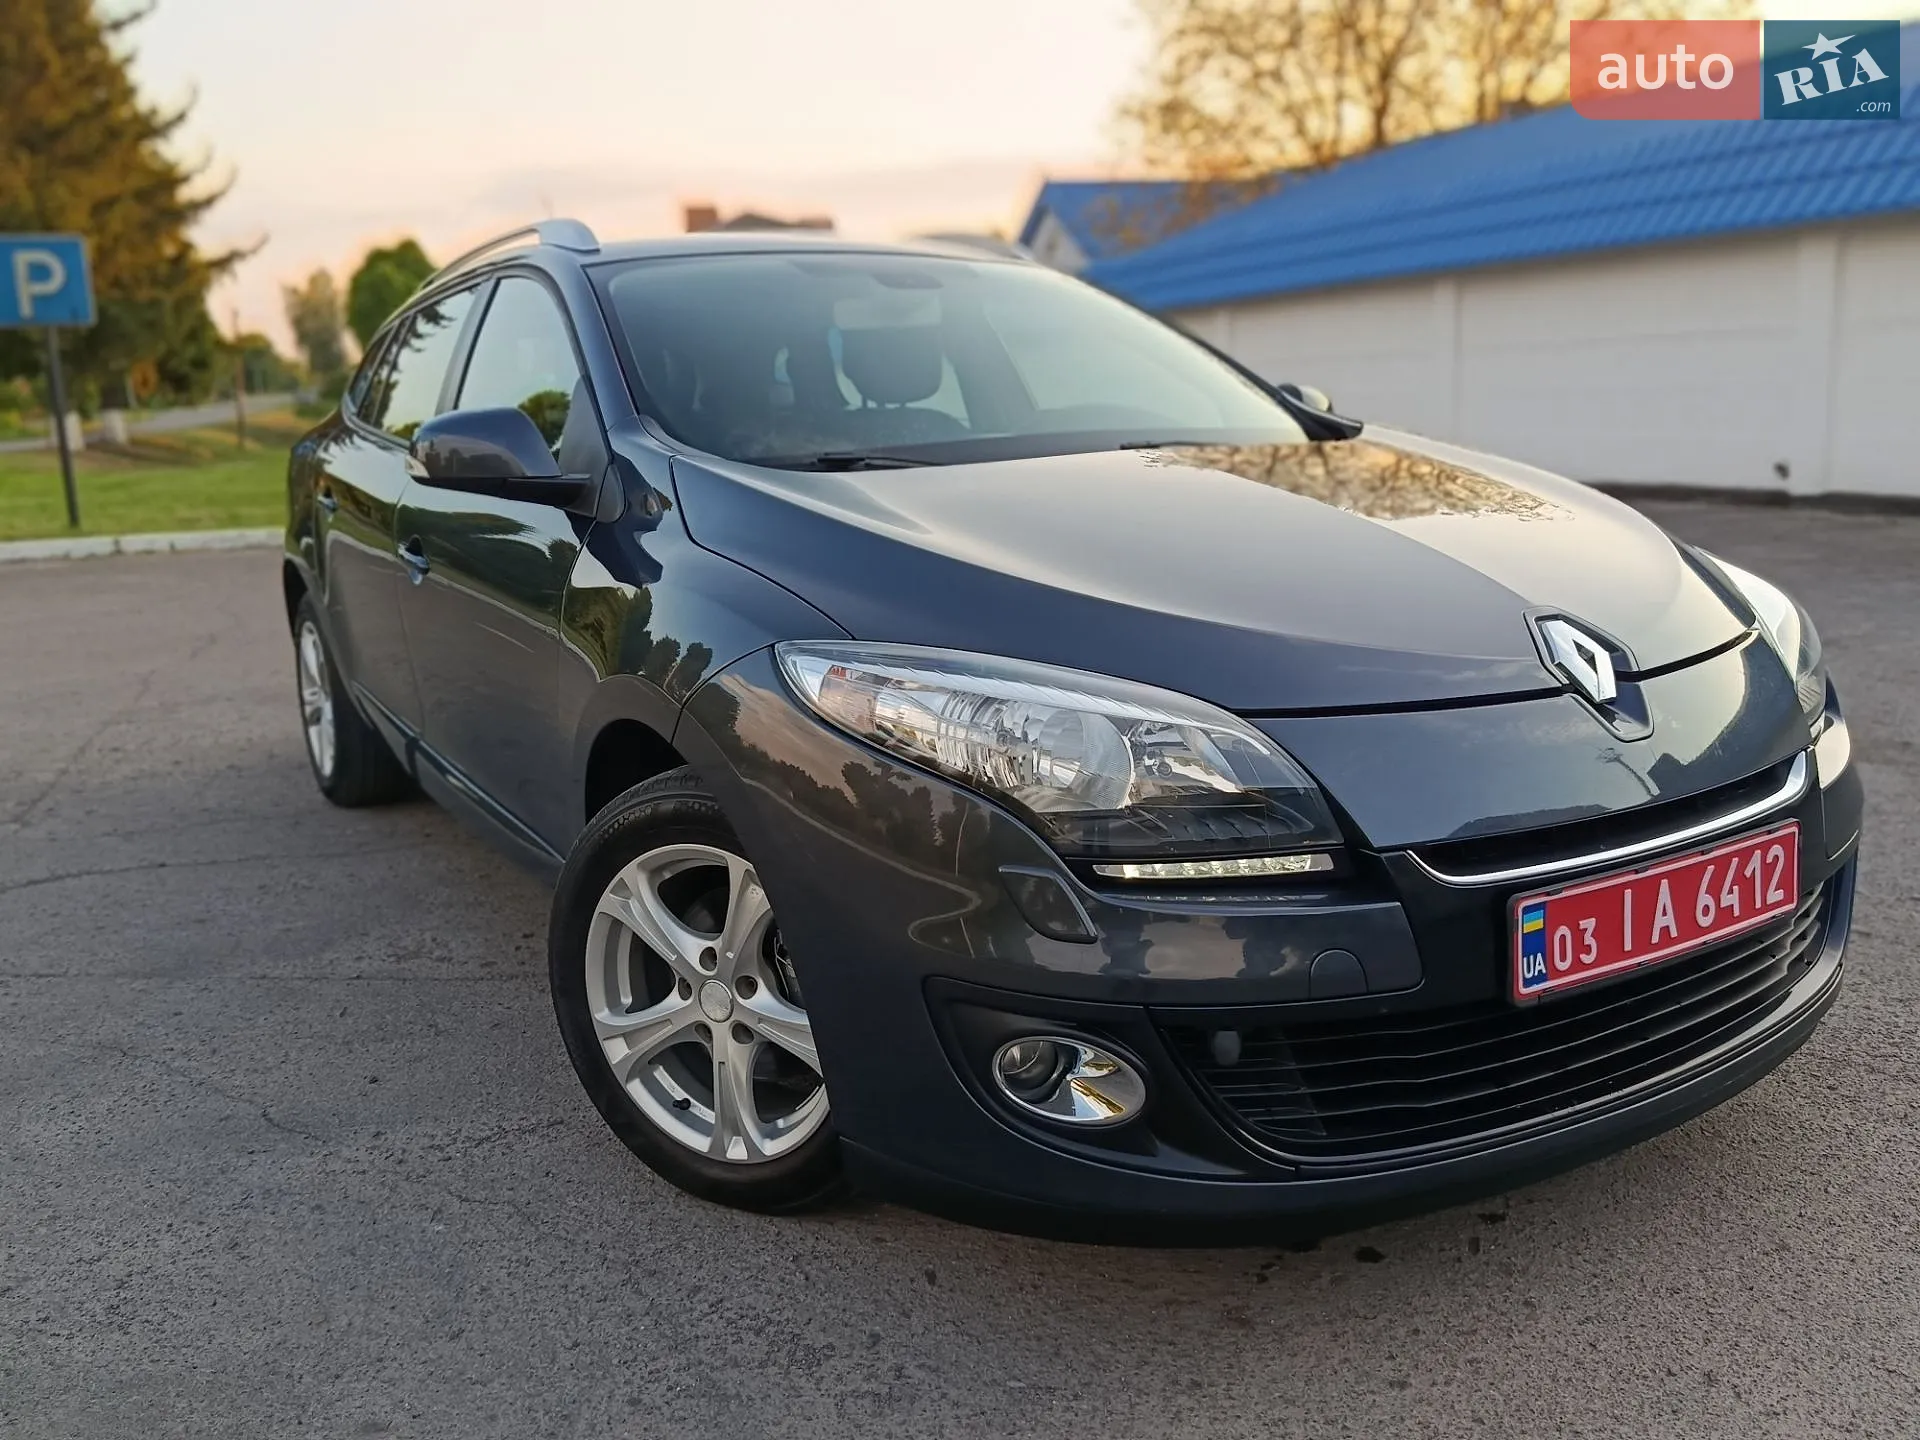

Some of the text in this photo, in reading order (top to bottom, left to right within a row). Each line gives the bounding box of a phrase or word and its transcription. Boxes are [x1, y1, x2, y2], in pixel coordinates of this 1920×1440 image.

[12, 250, 67, 320] P
[1553, 917, 1598, 971] 03
[1695, 844, 1785, 928] 6412
[1523, 952, 1546, 979] UA
